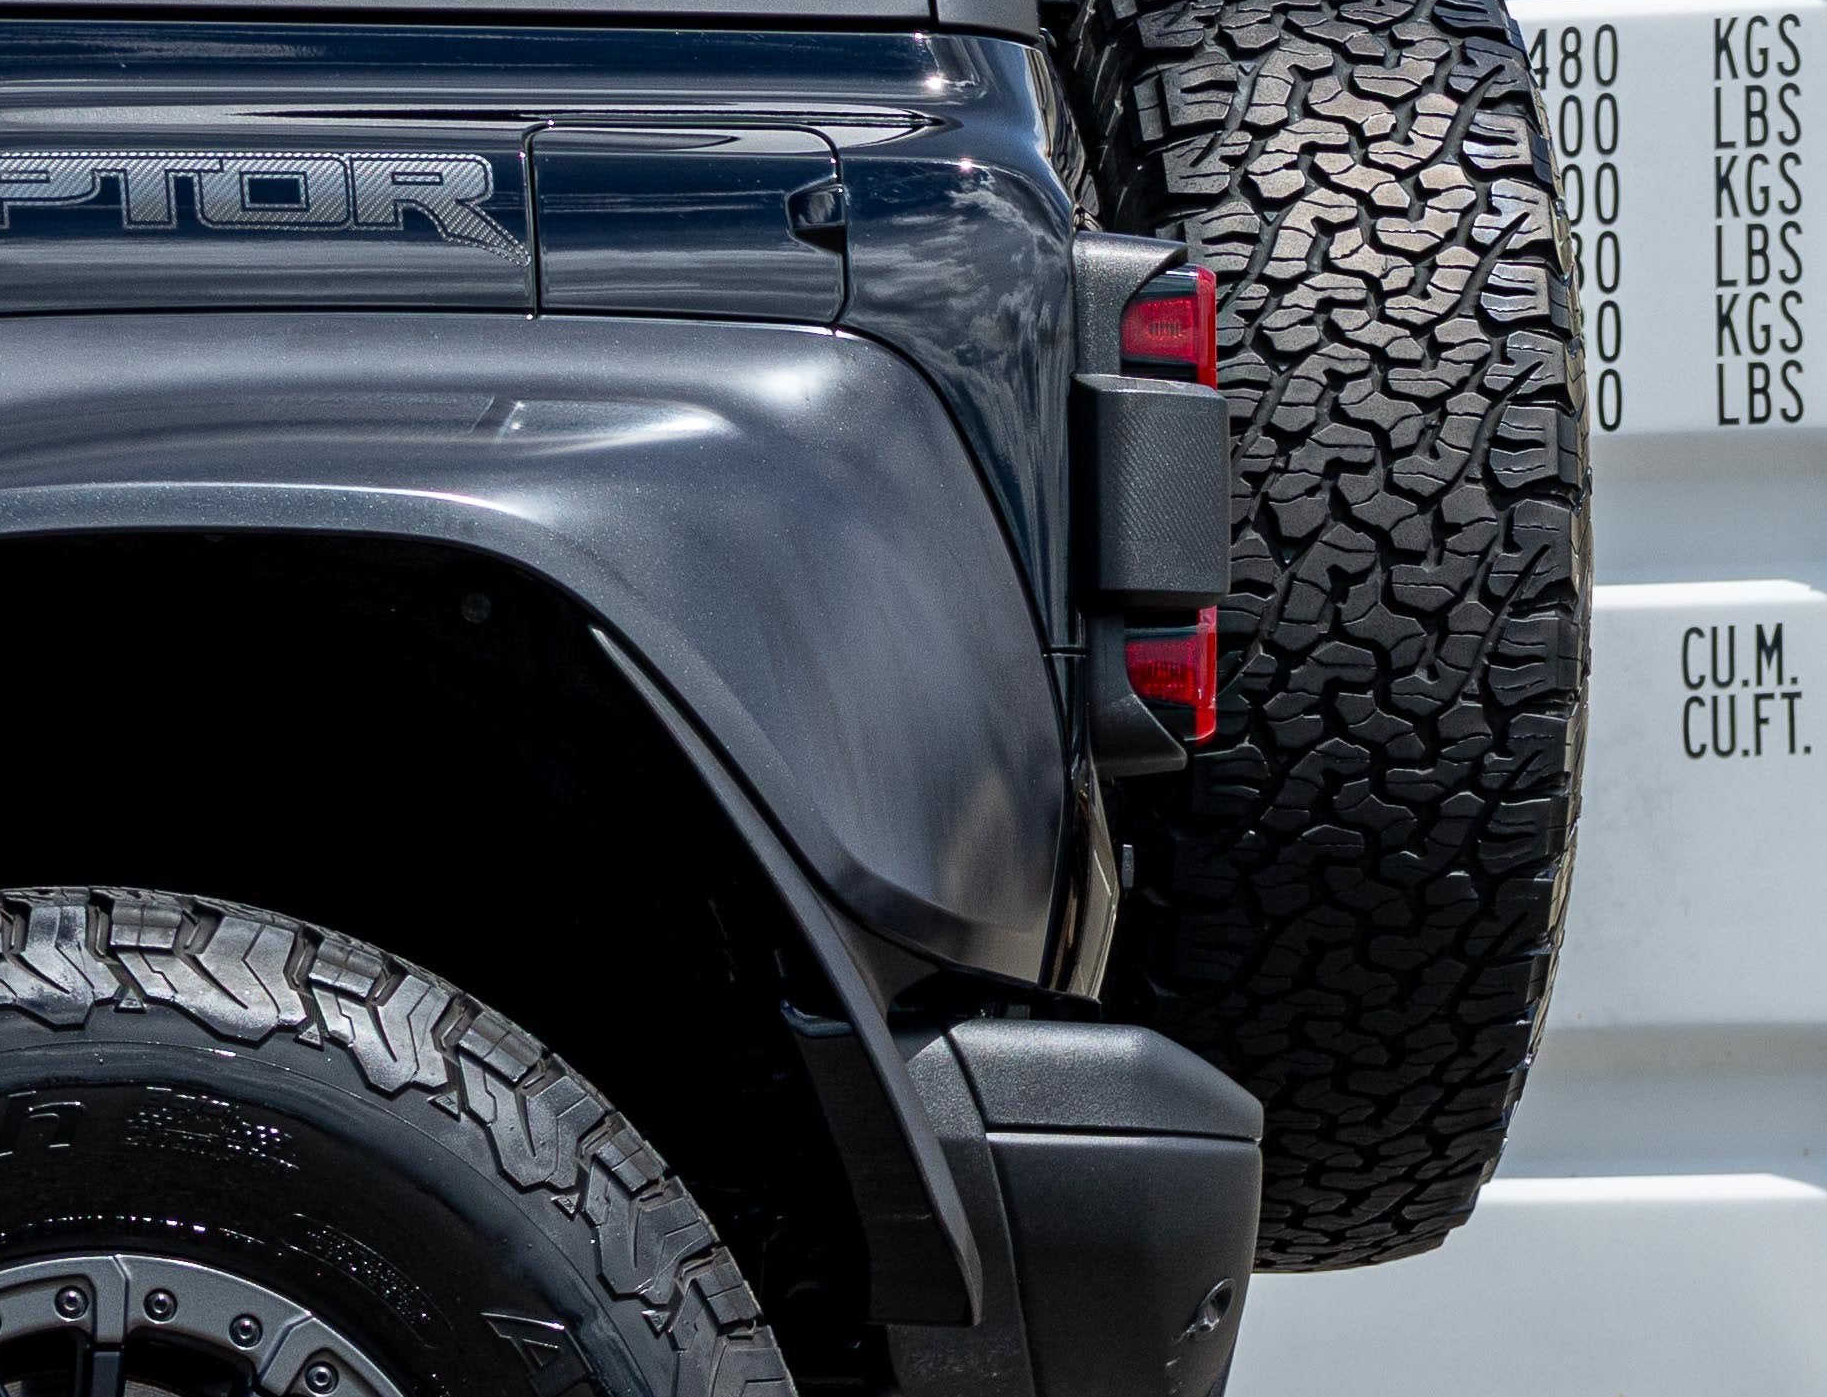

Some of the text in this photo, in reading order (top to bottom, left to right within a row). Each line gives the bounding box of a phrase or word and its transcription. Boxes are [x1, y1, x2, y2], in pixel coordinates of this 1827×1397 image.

[1714, 14, 1801, 81] KGS
[1715, 82, 1801, 149] LBS
[1716, 152, 1803, 219] KGS
[1716, 221, 1803, 288] LBS
[1717, 290, 1804, 357] KGS
[1717, 359, 1804, 426] LBS
